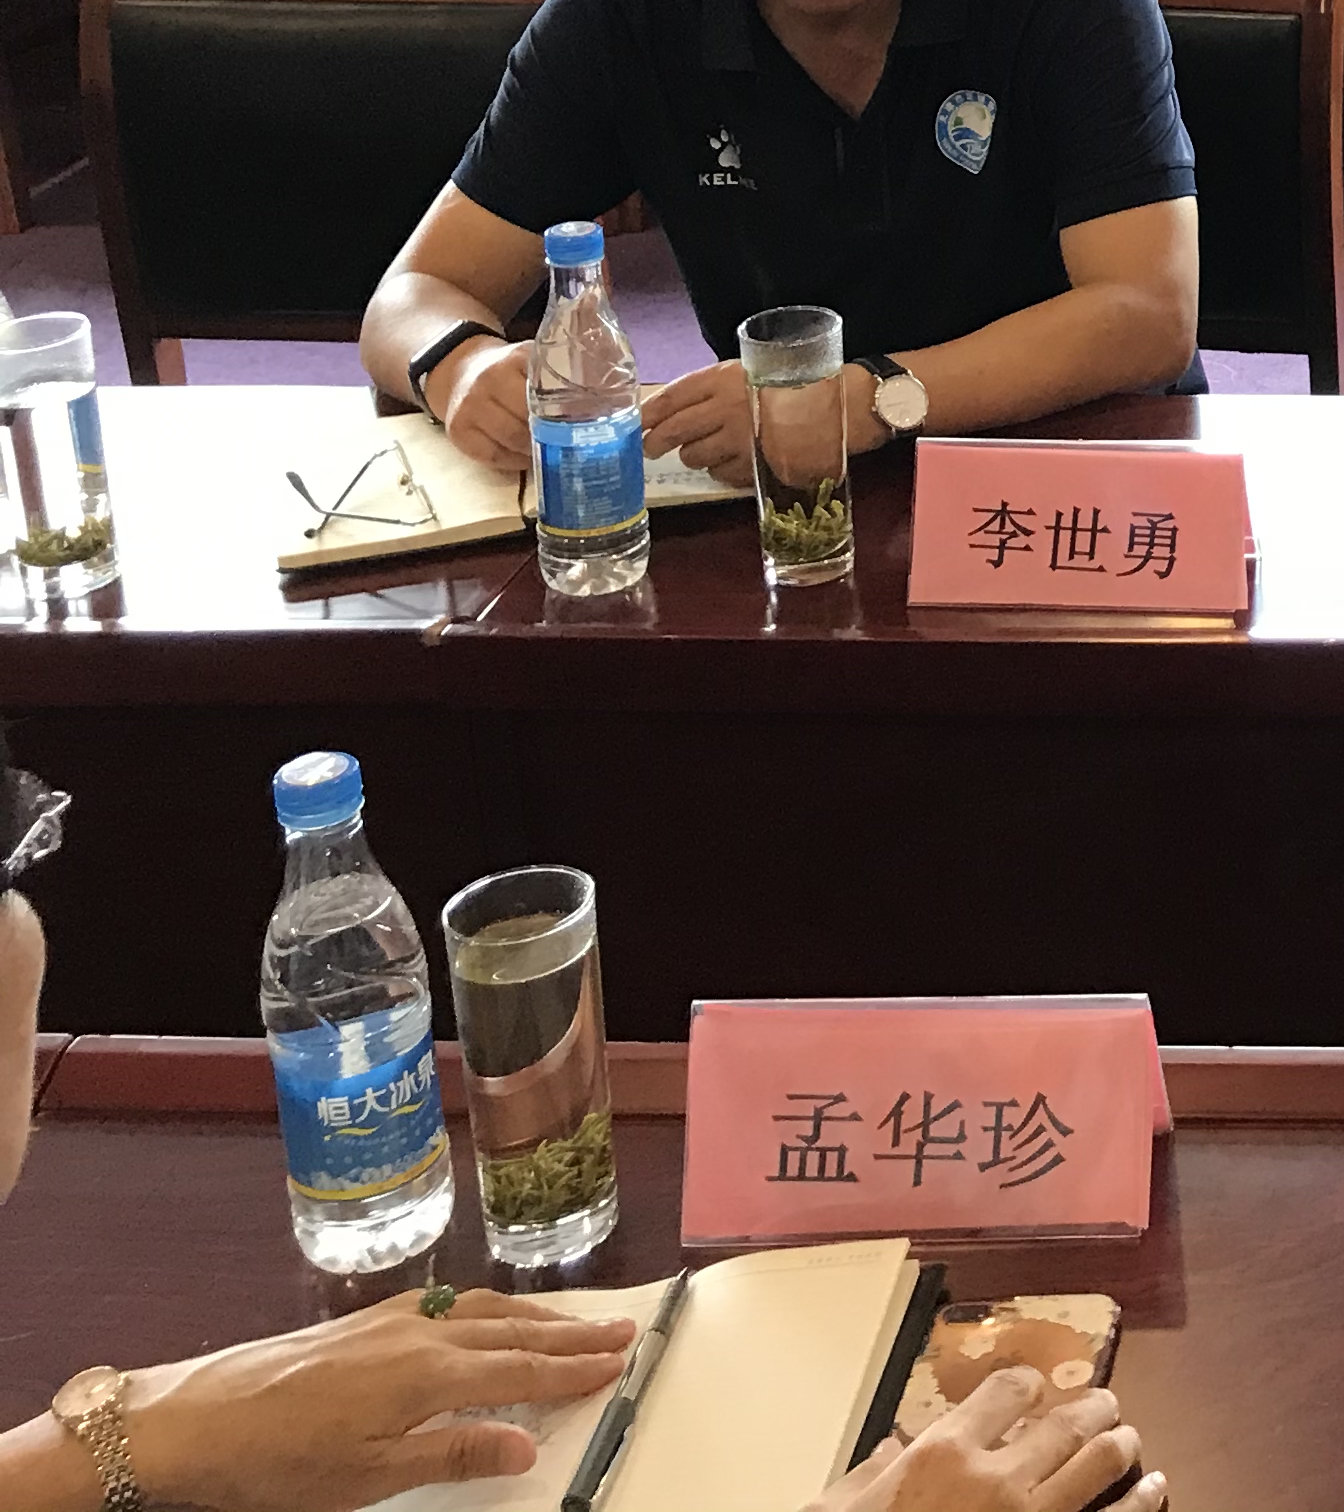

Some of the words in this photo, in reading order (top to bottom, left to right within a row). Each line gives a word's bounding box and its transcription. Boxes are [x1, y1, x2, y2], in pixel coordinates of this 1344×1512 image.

[967, 499, 1180, 580] 李世勇
[317, 1048, 436, 1127] 恒大冰泉
[765, 1090, 1075, 1190] 孟华珍
